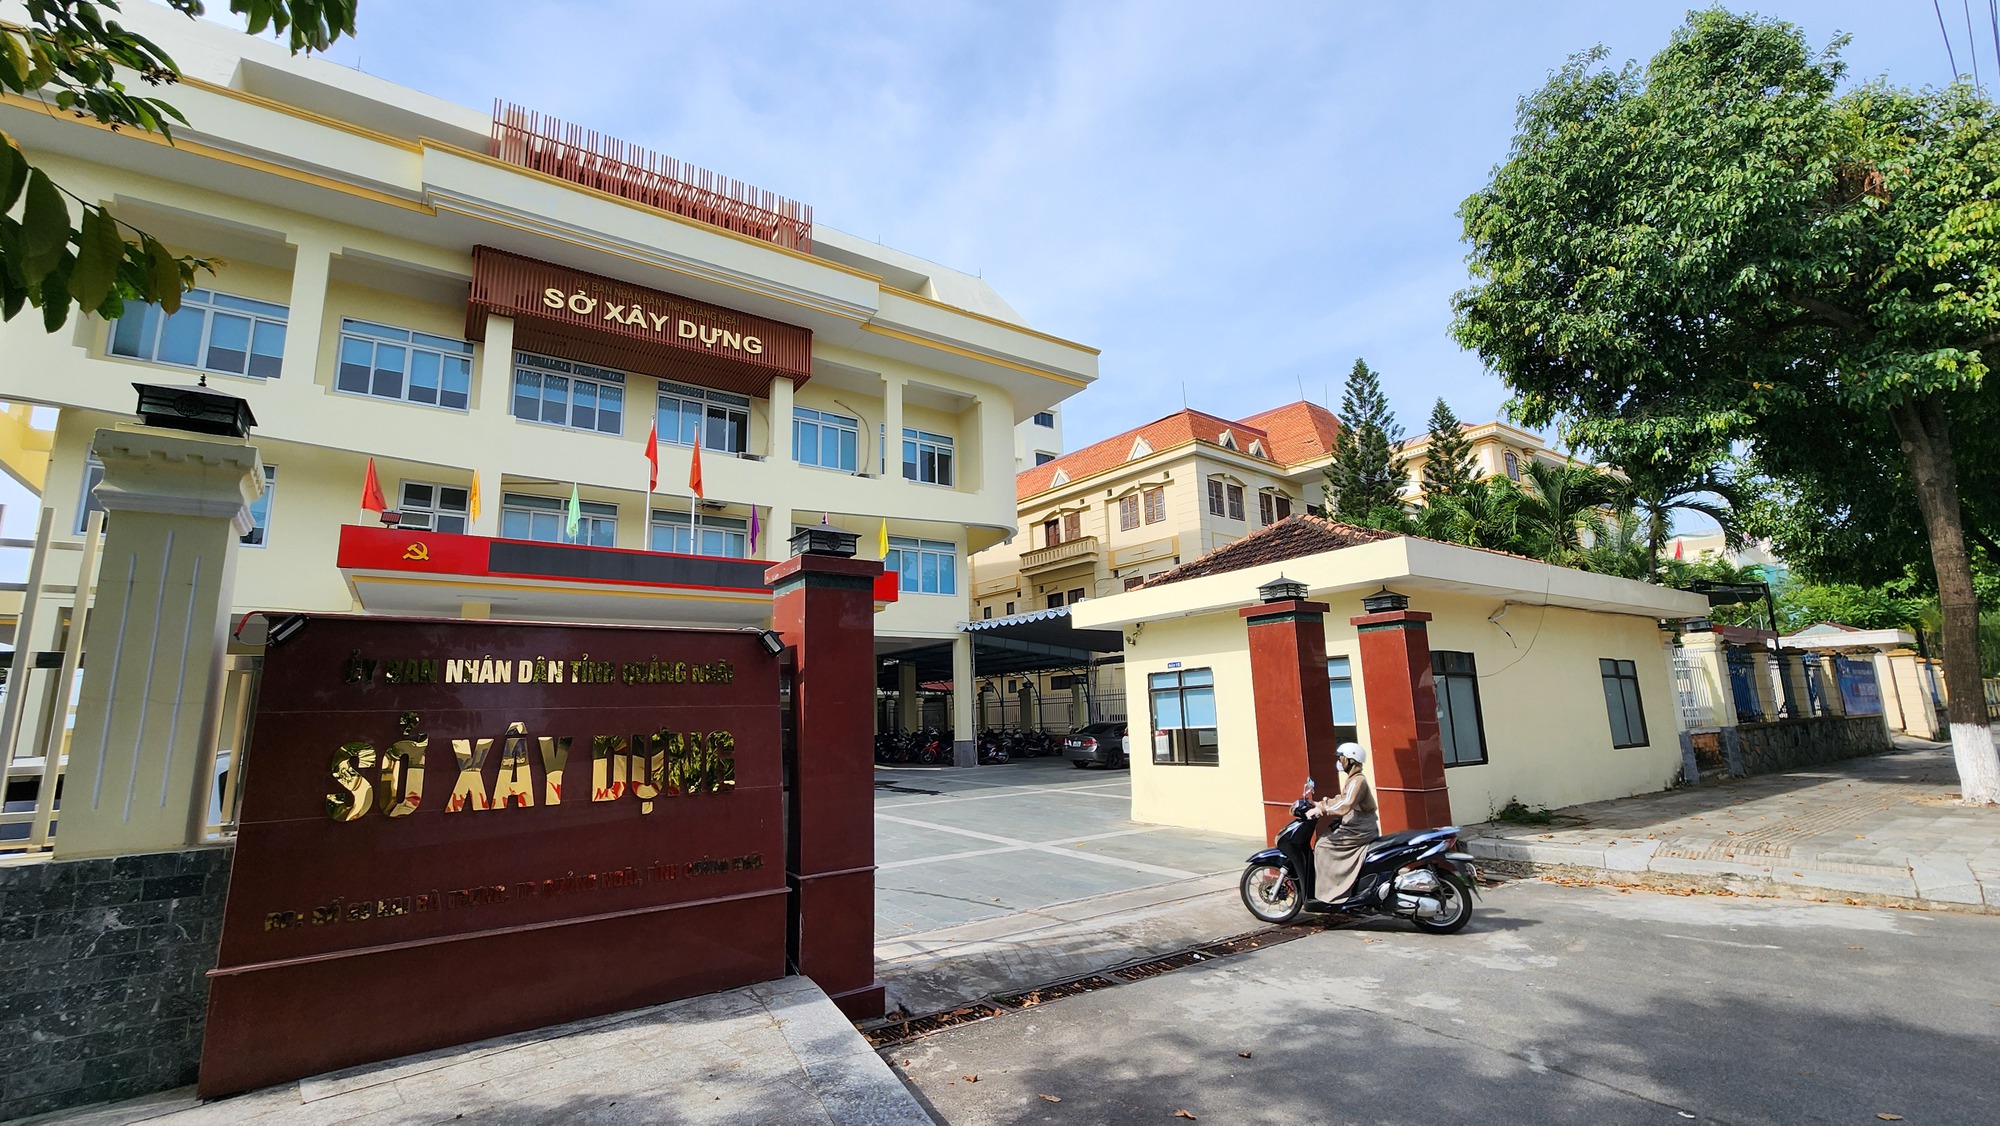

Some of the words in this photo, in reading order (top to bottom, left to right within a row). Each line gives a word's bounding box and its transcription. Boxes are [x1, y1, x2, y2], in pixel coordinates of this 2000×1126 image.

[591, 282, 613, 295] BAN
[543, 287, 597, 315] SỞ
[604, 301, 669, 332] XÂY
[678, 319, 762, 354] DỰNG
[386, 659, 439, 684] BAN
[445, 654, 512, 684] NHÂN
[517, 655, 564, 684] DÂN
[570, 652, 616, 684] TỈNH
[621, 653, 687, 685] QUẢNG
[691, 657, 734, 684] NGÃI
[326, 711, 430, 823] SỞ
[444, 721, 574, 813] XÂY
[591, 726, 736, 815] DỰNG
